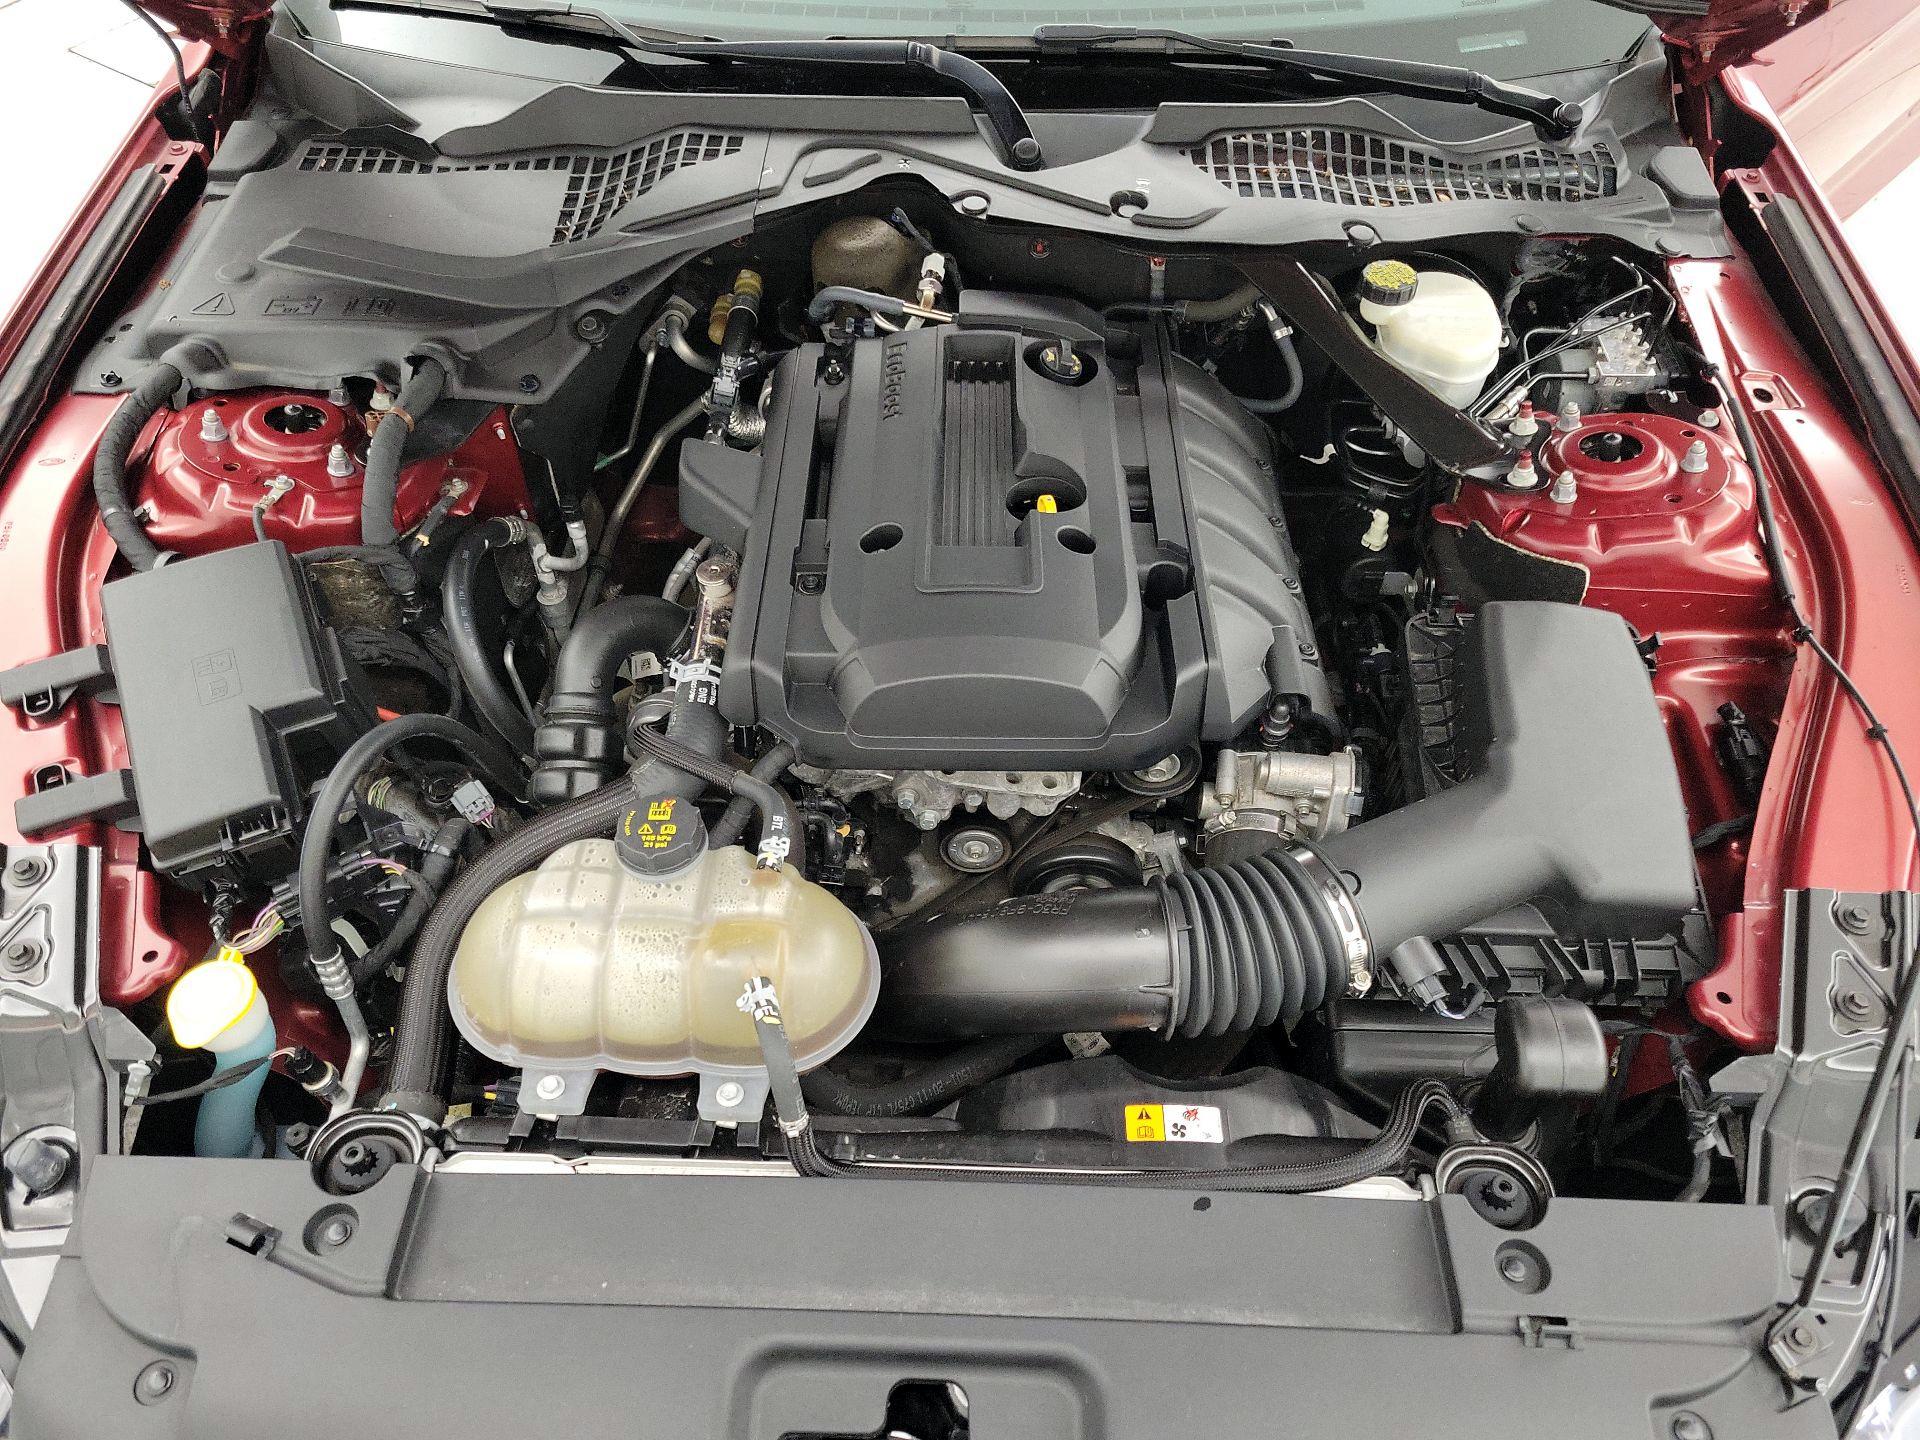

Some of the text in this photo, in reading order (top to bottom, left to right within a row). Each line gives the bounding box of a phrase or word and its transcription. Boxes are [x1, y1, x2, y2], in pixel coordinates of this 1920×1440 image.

[882, 342, 908, 420] EcoBoost
[697, 687, 708, 703] ENG
[771, 815, 784, 831] BTL
